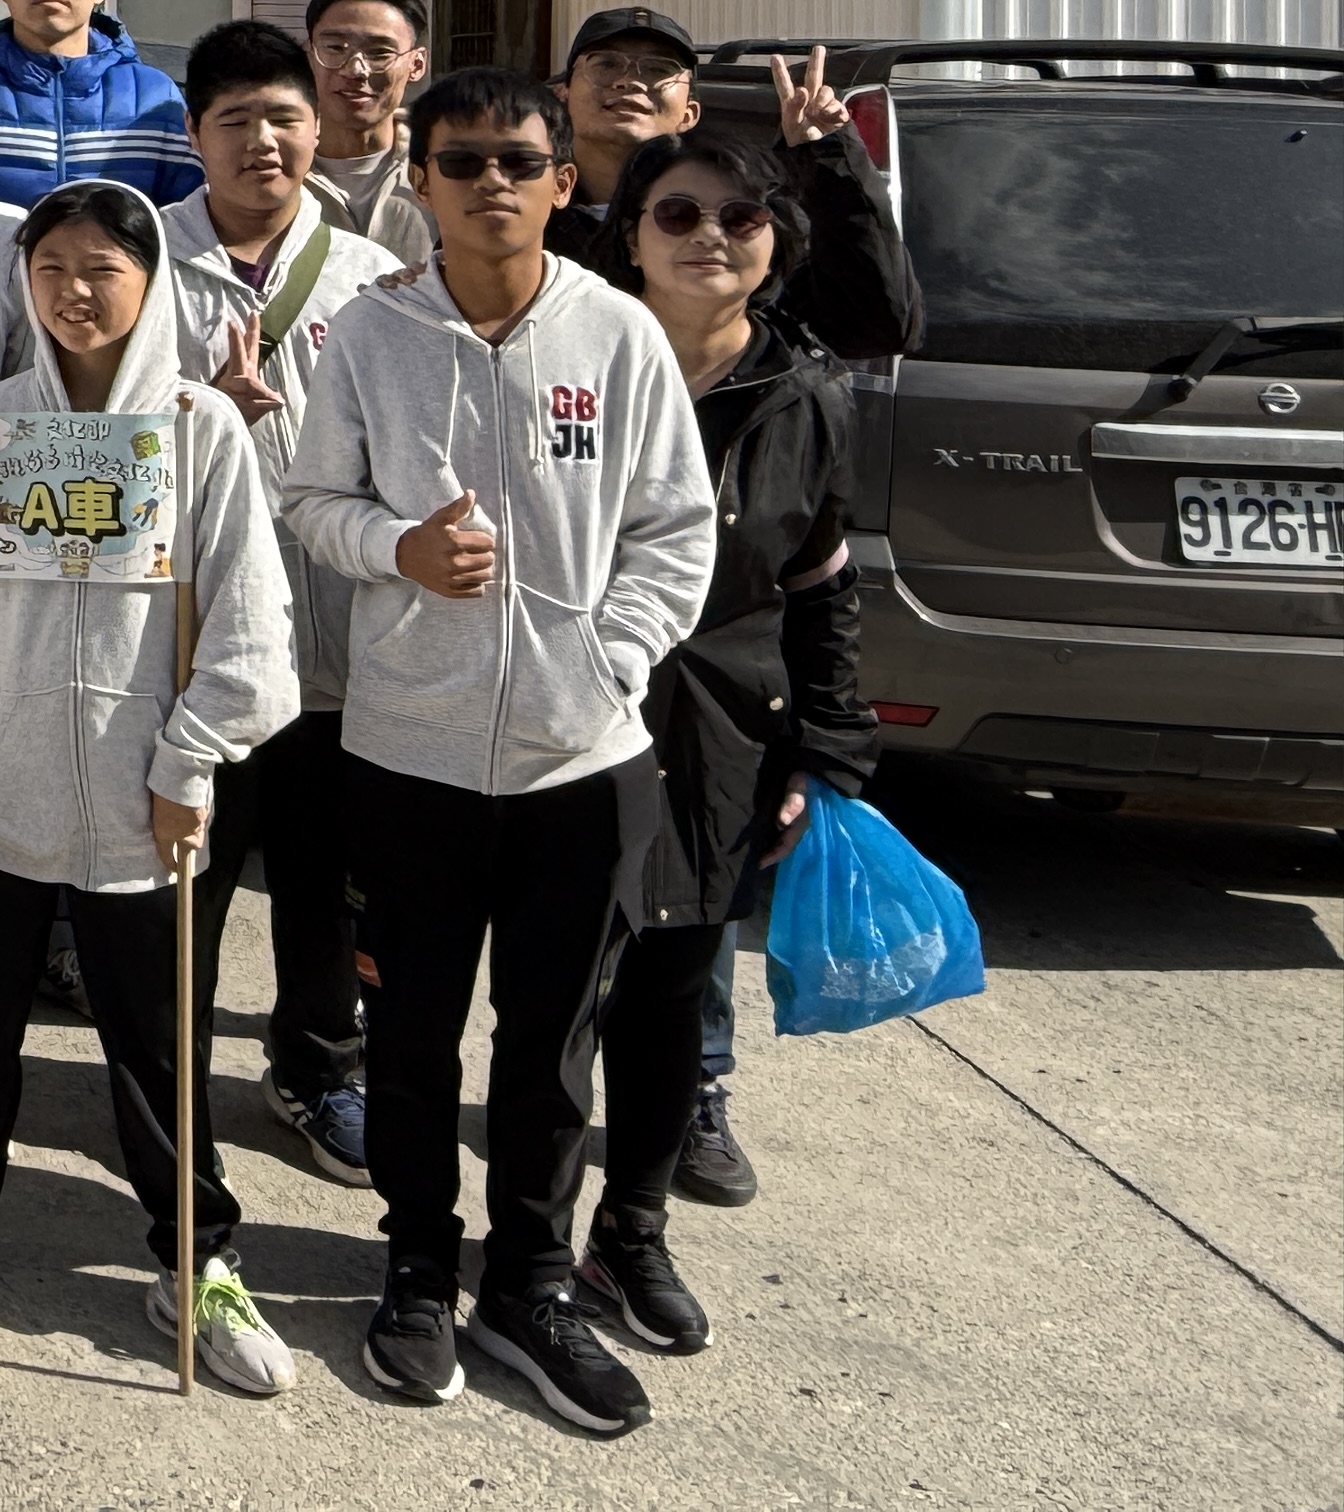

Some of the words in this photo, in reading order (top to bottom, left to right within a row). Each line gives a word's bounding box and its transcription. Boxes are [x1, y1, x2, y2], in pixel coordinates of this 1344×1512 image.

[552, 385, 597, 421] GB
[552, 423, 596, 459] JH
[933, 448, 1083, 473] X-TRAIL
[20, 477, 126, 543] A車
